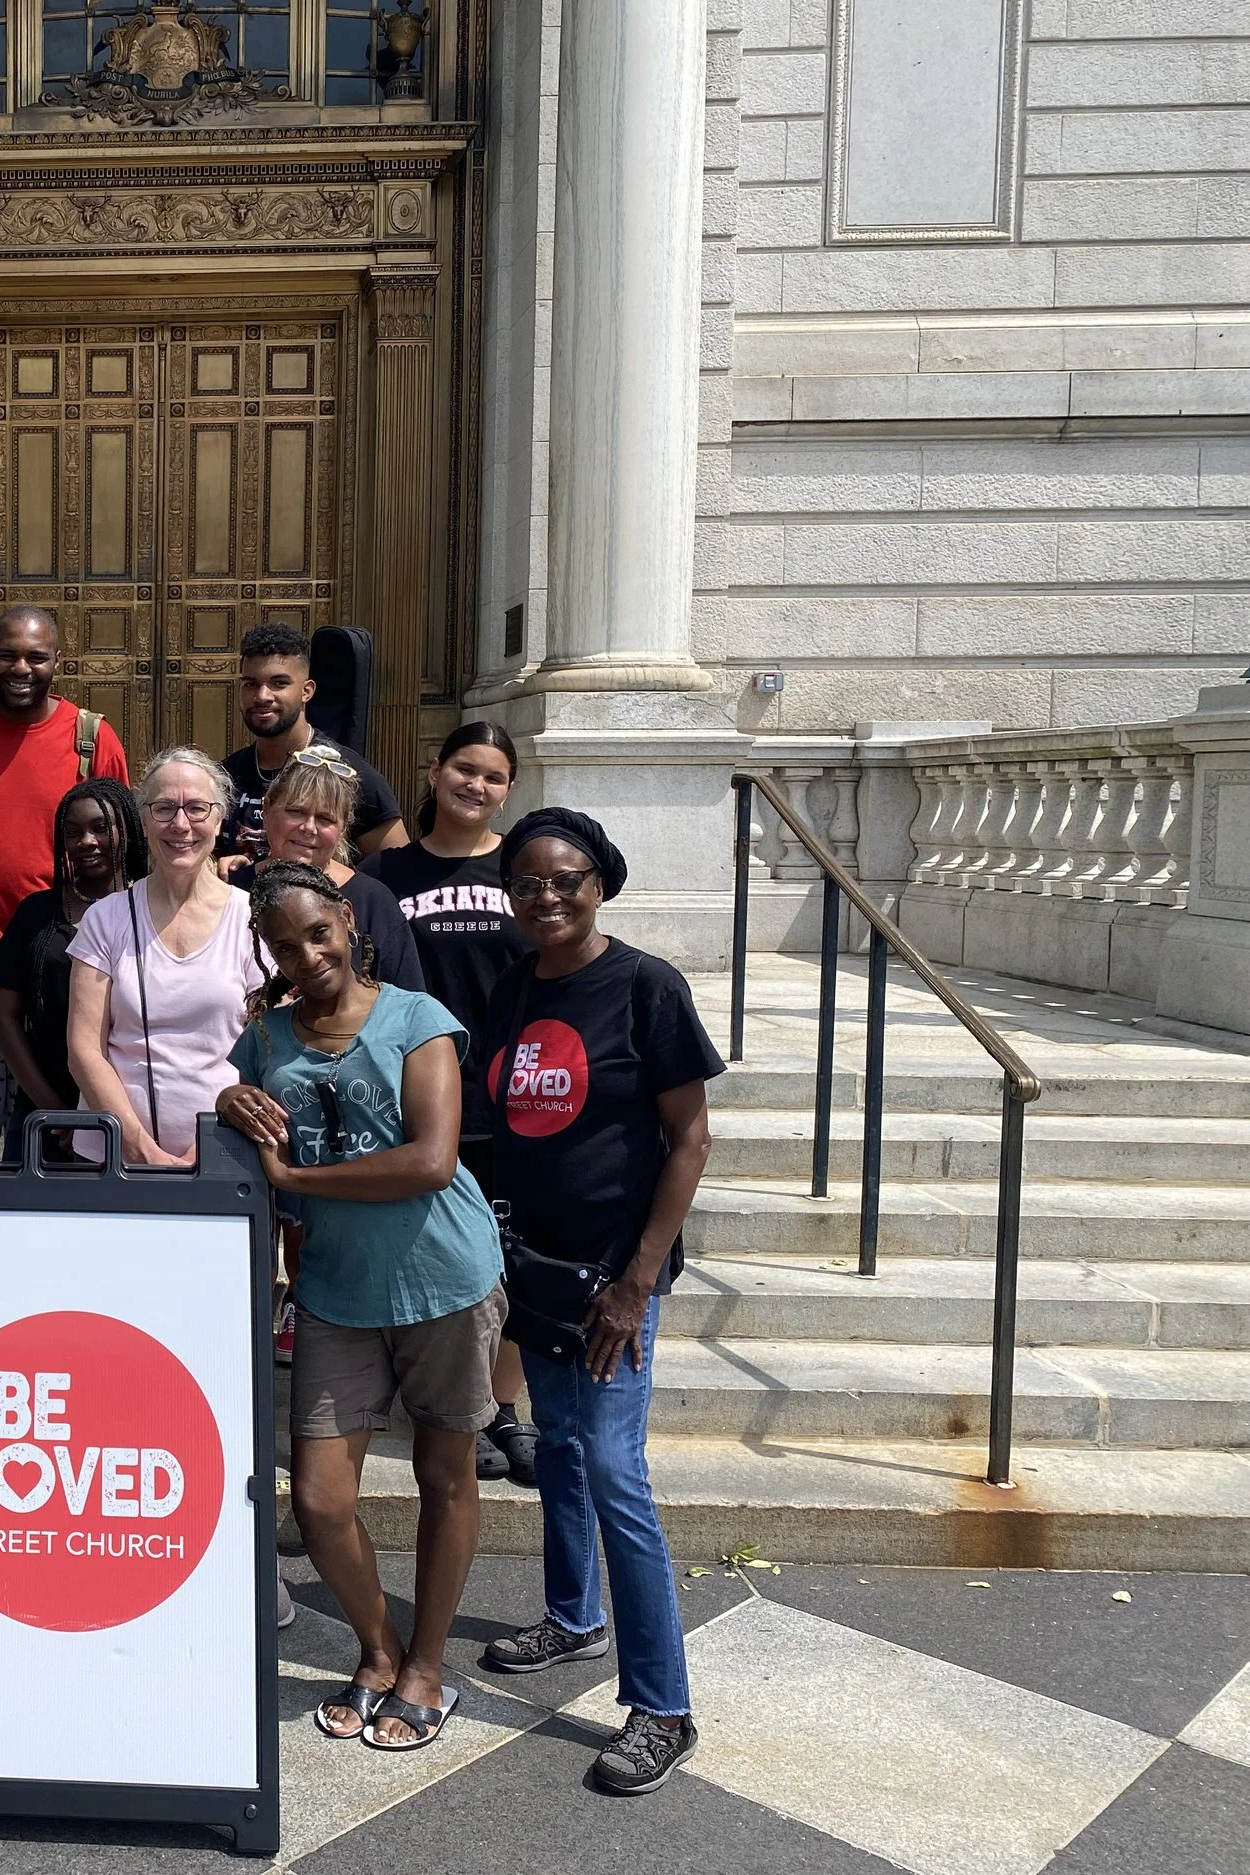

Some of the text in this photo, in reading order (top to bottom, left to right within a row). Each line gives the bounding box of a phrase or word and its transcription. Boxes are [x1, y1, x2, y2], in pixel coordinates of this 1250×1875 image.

[101, 71, 125, 82] POST
[147, 90, 181, 99] NUBILA
[430, 920, 501, 932] GREECE
[513, 1043, 542, 1070] BE
[507, 1068, 572, 1097] OVED
[337, 1079, 402, 1126] OVE
[533, 1101, 573, 1113] CHURCH
[65, 1531, 185, 1559] CHURCH
